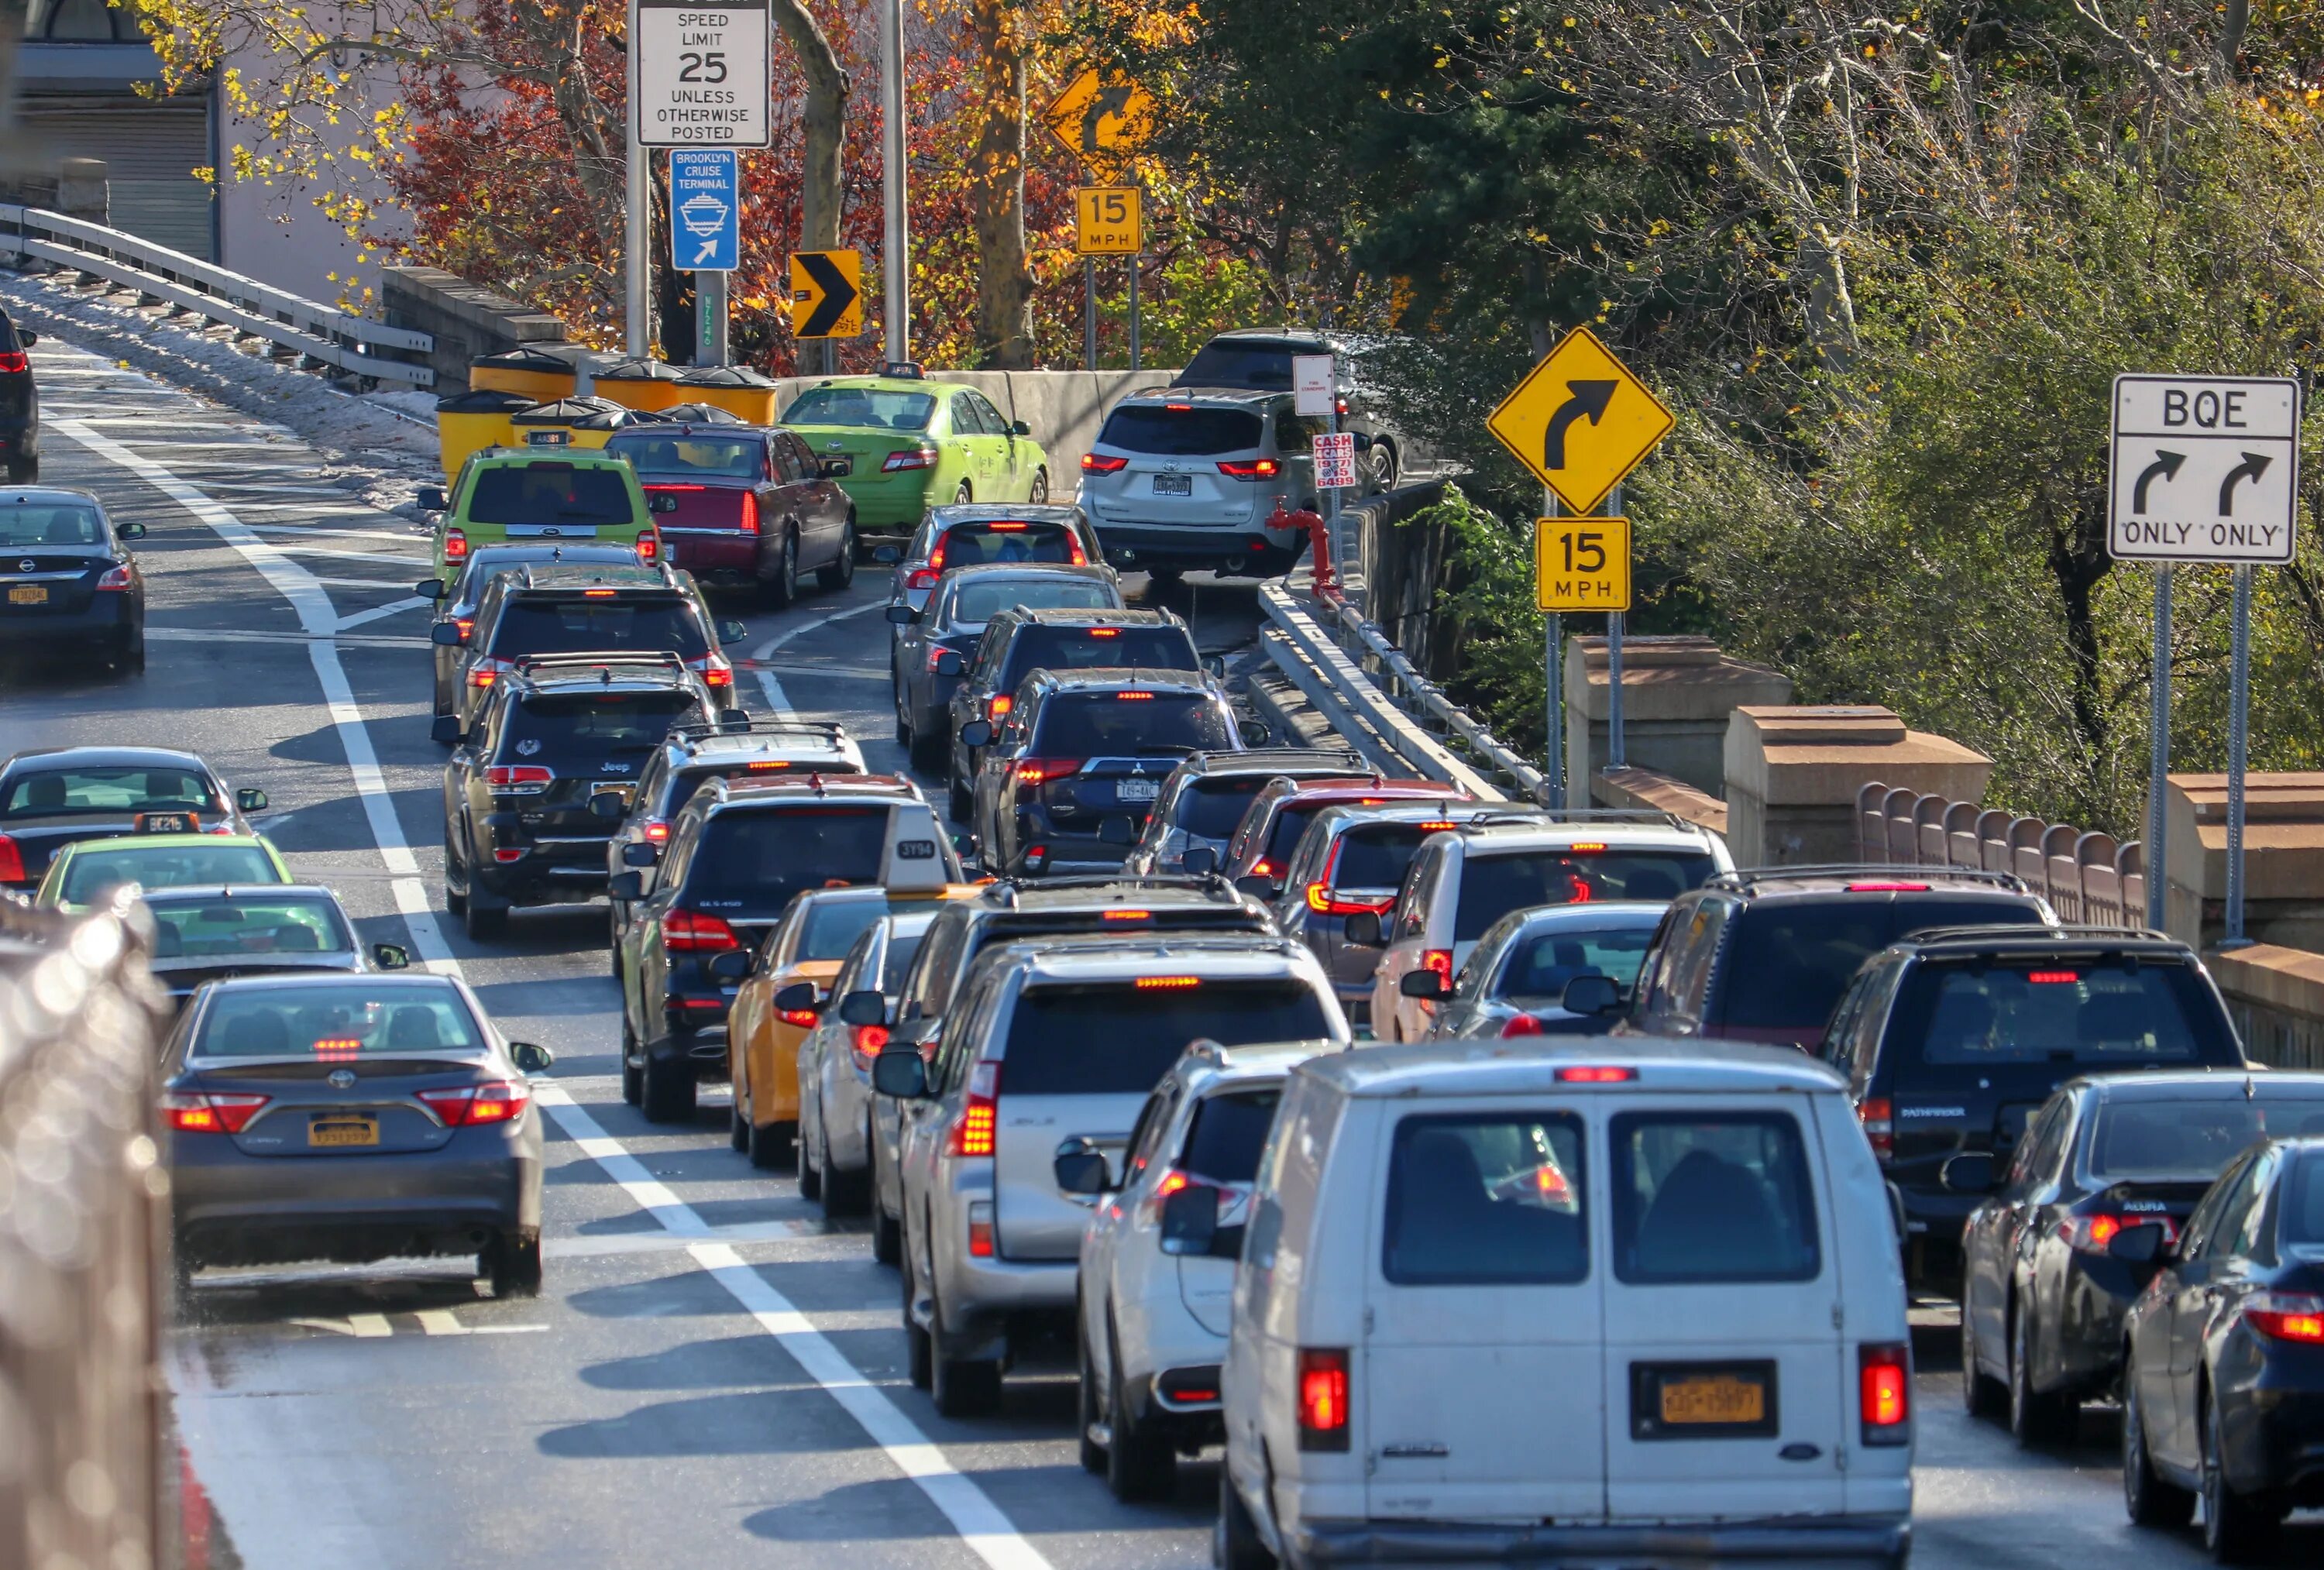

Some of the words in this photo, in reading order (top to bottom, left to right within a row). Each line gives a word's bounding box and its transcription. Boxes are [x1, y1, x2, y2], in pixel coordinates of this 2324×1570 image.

[678, 13, 729, 27] SPEED
[682, 33, 723, 46] LIMIT
[679, 53, 727, 84] 25
[672, 90, 735, 104] UNLESS
[657, 108, 749, 122] OTHERWISE
[672, 127, 734, 139] POSTED
[676, 153, 731, 163] BROOKLYN
[685, 166, 722, 177] CRUISE
[679, 179, 730, 189] TERMINAL
[1092, 194, 1126, 224] 15
[1090, 234, 1129, 246] MPH
[2164, 390, 2247, 428] BQE
[1317, 476, 1354, 486] 6499
[2125, 521, 2192, 544] ONLY
[2211, 524, 2278, 546] ONLY
[1560, 533, 1606, 572] 15
[1556, 581, 1611, 597] MPH
[601, 762, 631, 773] Jeep
